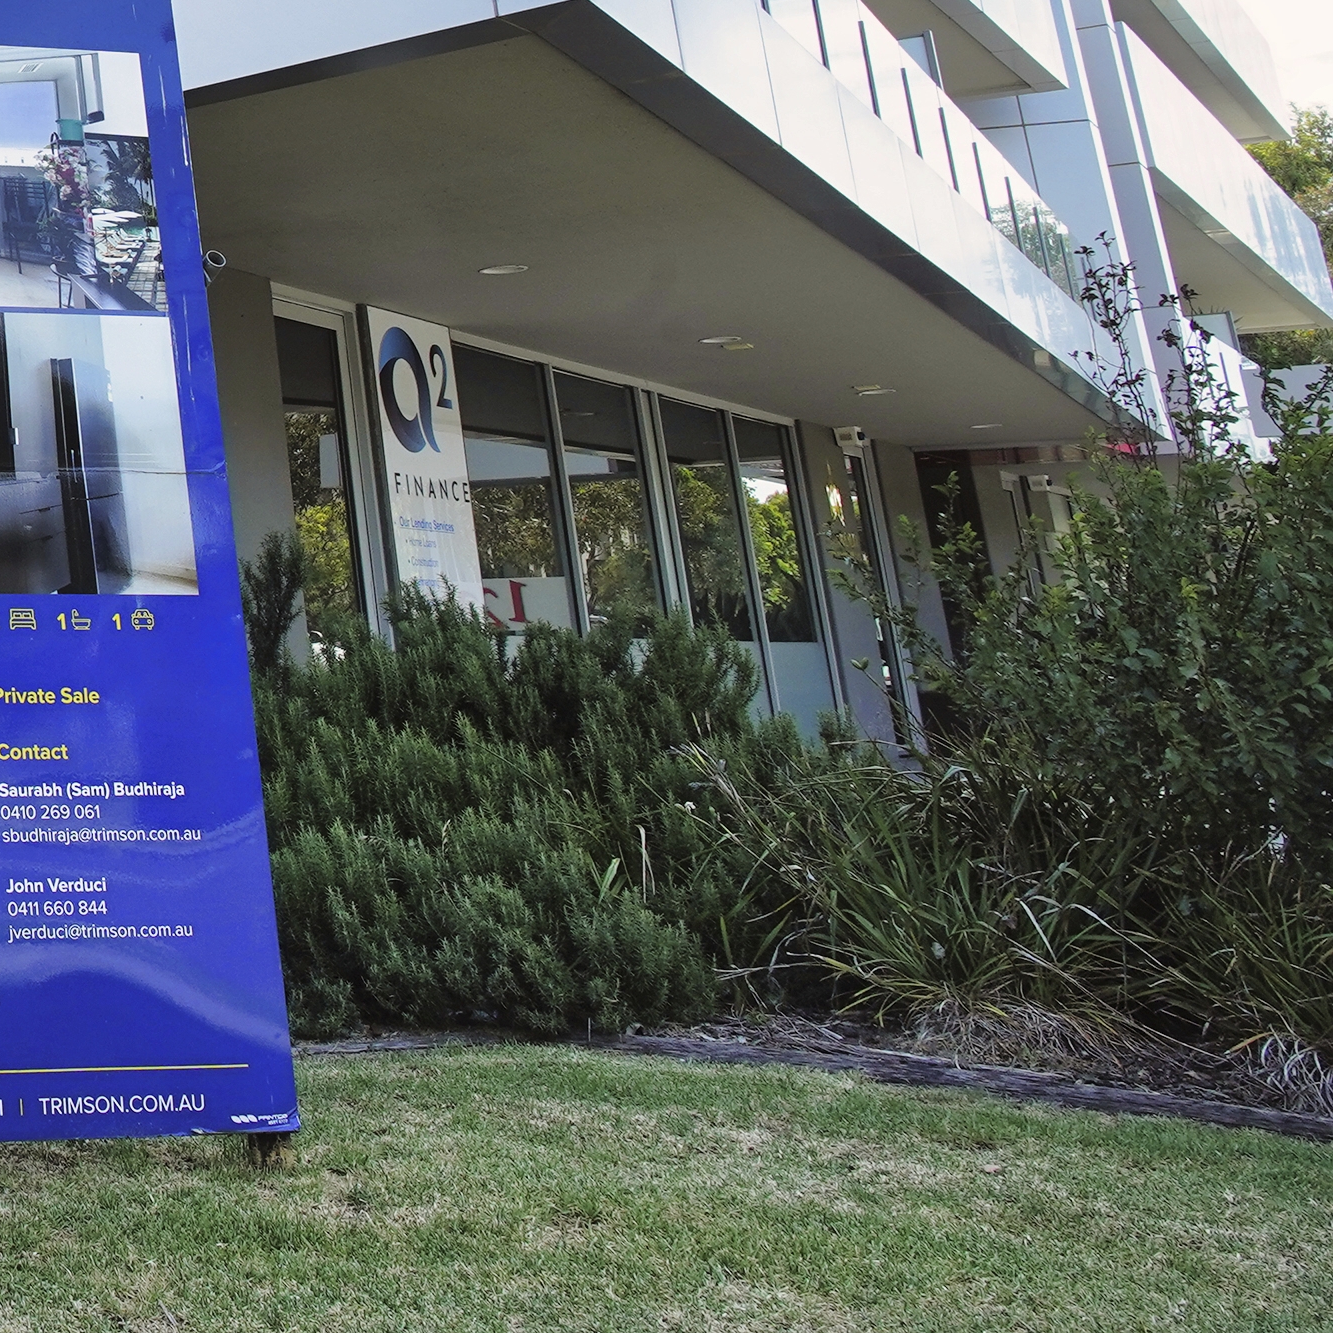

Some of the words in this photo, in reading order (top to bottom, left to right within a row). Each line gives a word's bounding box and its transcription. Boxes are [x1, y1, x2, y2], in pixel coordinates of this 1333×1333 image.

[394, 472, 471, 503] FINANCE
[57, 613, 67, 631] 1
[112, 613, 122, 630] 1
[60, 687, 100, 704] Sale
[66, 782, 110, 800] (Sam)
[113, 781, 185, 799] Budhiraja
[0, 804, 36, 820] 0410
[40, 804, 71, 820] 269
[74, 804, 100, 819] 061
[1, 827, 201, 846] sbudhiraja@trimson.com.au
[6, 878, 44, 893] John
[47, 877, 107, 893] Verduci
[7, 901, 39, 917] 0411
[43, 900, 74, 916] 660
[78, 900, 108, 915] 844
[7, 923, 193, 944] jverduci@trimson.com.au
[38, 1094, 205, 1115] TRIMSON.COM.AU
